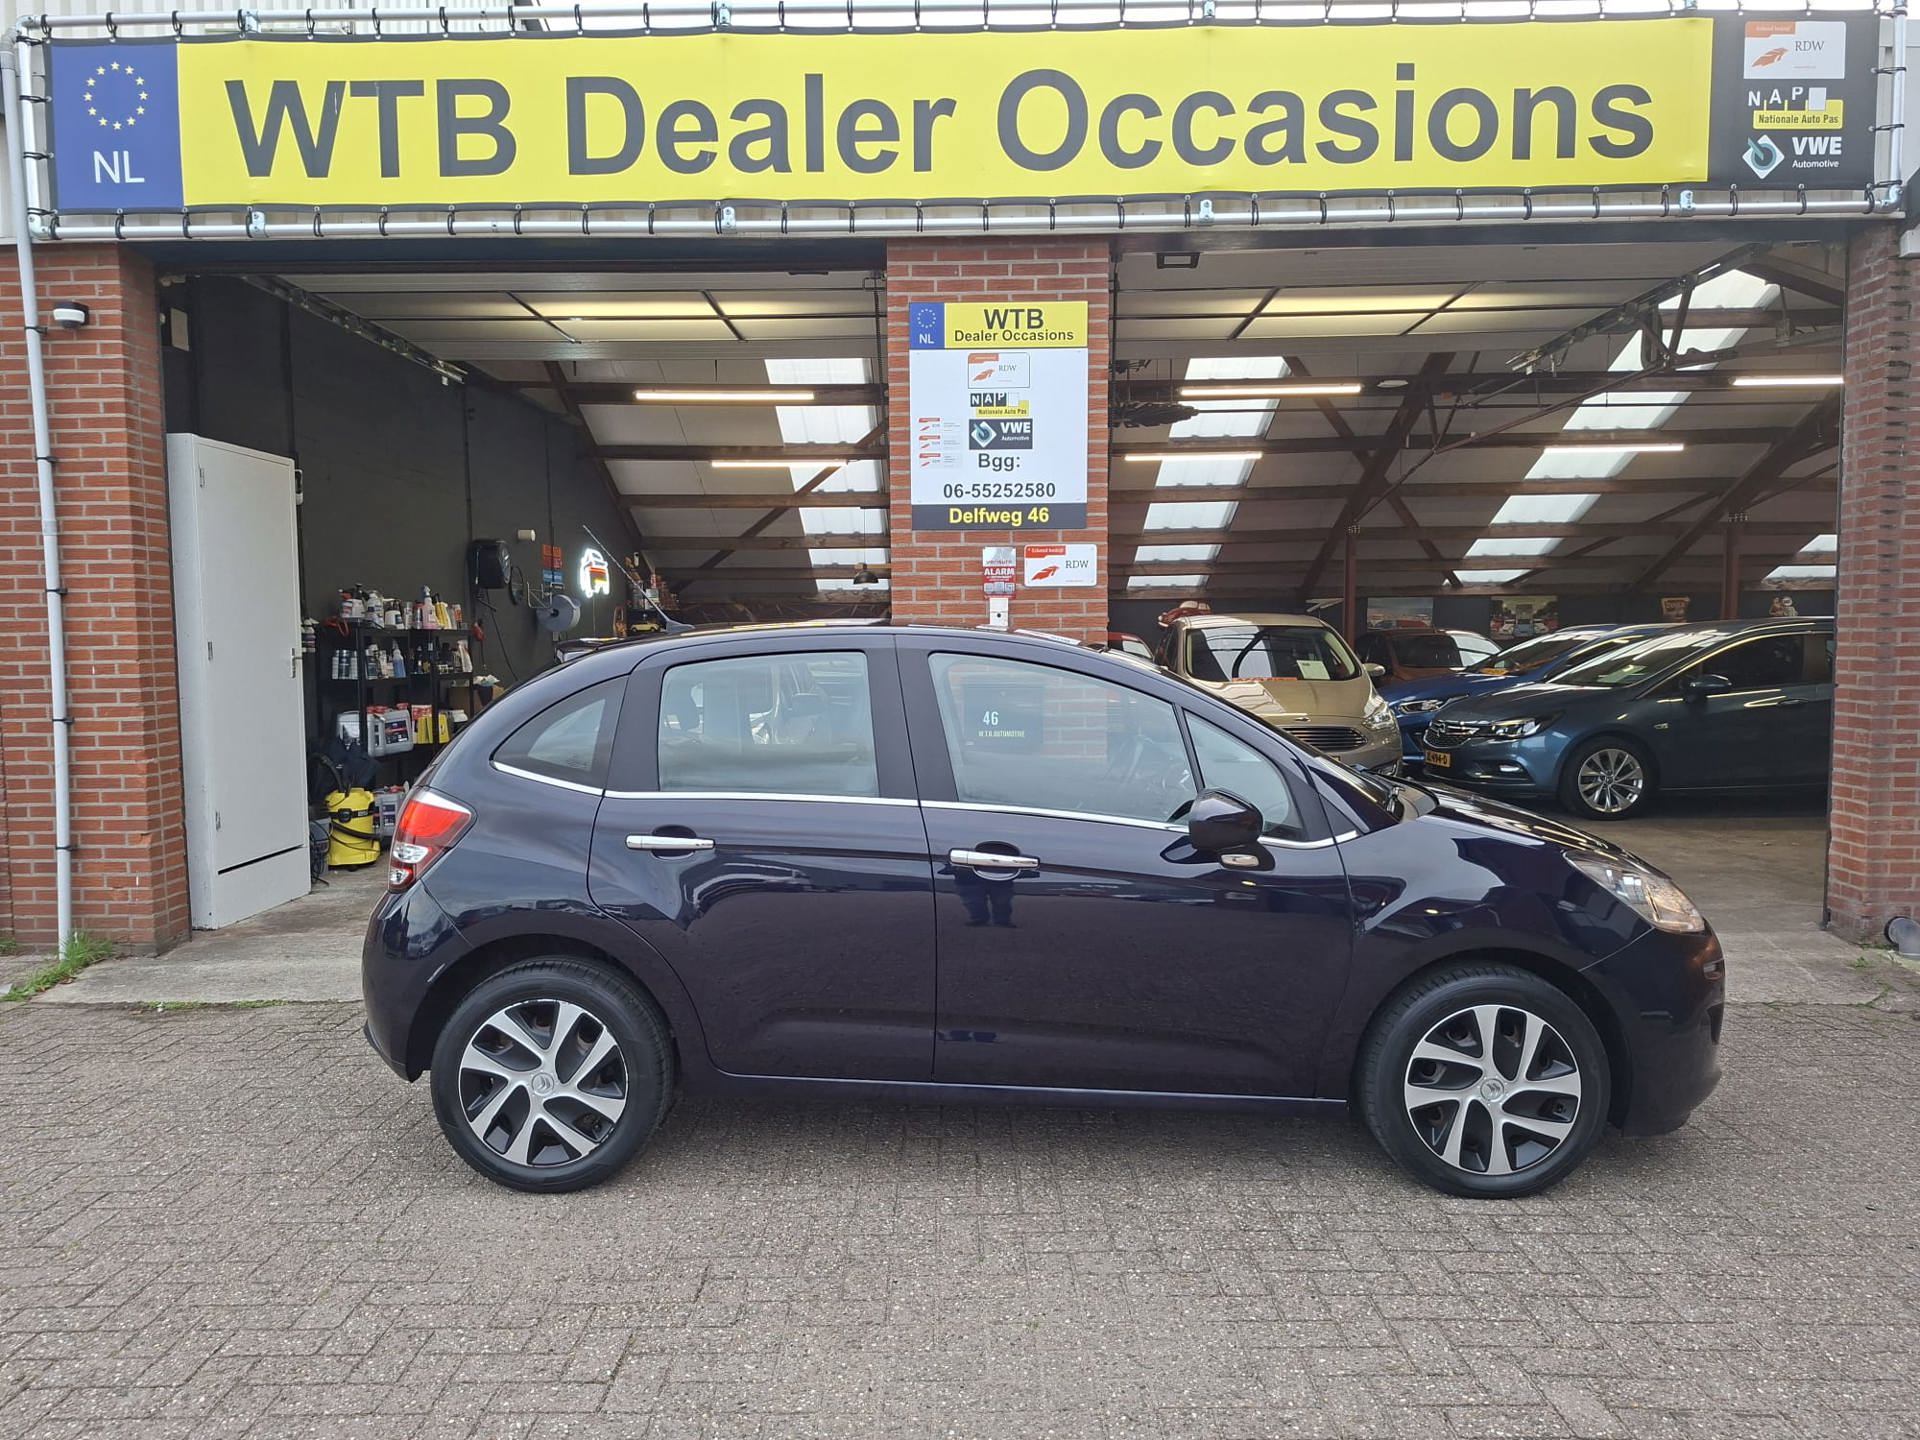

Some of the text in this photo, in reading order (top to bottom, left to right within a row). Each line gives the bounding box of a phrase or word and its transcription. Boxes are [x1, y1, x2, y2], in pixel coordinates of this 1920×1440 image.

[1795, 41, 1825, 51] RDW
[225, 63, 1654, 178] WTB Dealer Occasions
[1758, 115, 1839, 124] Nationale Auto Pas
[1792, 137, 1842, 155] VWE
[93, 150, 146, 184] NL
[1792, 160, 1840, 168] Automotive
[984, 308, 1044, 330] WTB
[919, 333, 935, 344] NL
[954, 329, 1074, 342] Dealer Occasions
[1000, 422, 1031, 433] VWE
[978, 453, 1020, 471] Bgg:
[943, 483, 1056, 498] 06-55252580
[949, 507, 1050, 526] Delfweg 46
[984, 567, 1015, 576] ALARM
[1065, 560, 1089, 569] RDW
[982, 711, 999, 726] 46
